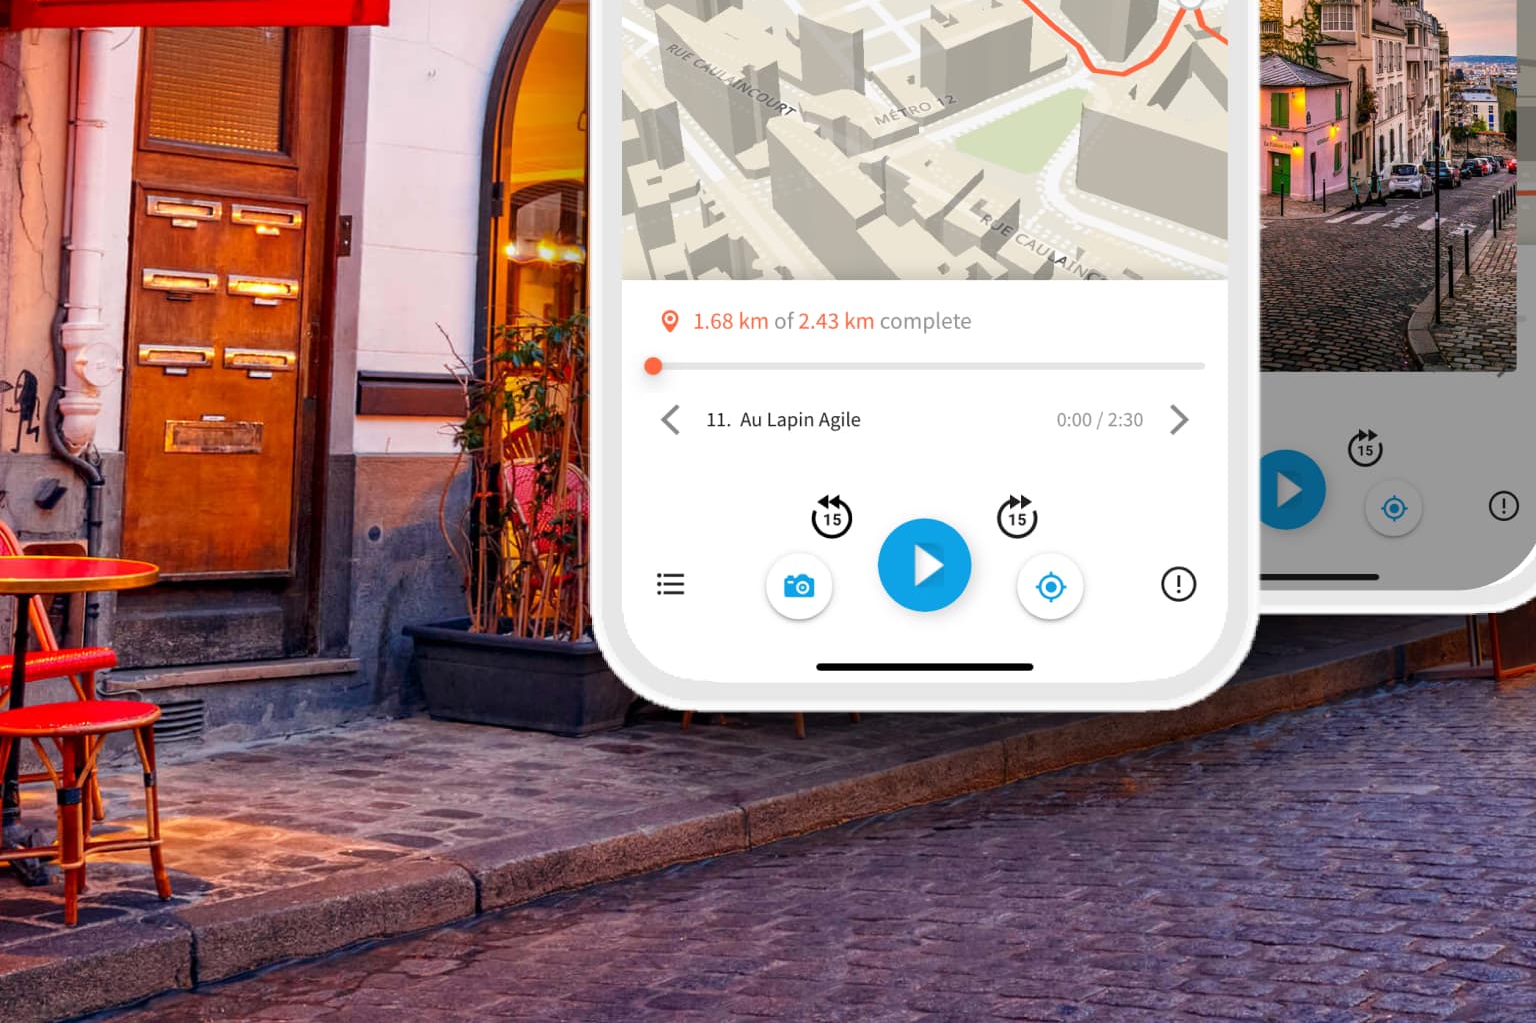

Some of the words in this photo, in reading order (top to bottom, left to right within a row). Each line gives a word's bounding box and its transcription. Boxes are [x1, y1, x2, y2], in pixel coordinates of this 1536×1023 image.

[665, 43, 692, 62] RUE
[692, 56, 798, 117] CAULAINCOURT
[873, 100, 932, 127] MÉTRO
[936, 94, 958, 108] 12
[979, 213, 1015, 237] RUE
[1014, 233, 1109, 280] CAULAINC
[694, 312, 734, 330] 1.68
[739, 311, 769, 330] km
[774, 311, 795, 330] of
[798, 312, 839, 330] 2.43
[845, 311, 875, 330] km
[880, 311, 972, 334] complete
[706, 412, 731, 428] 11.
[739, 411, 762, 428] Au
[767, 411, 814, 432] Lapin
[818, 410, 861, 432] Agile
[1057, 412, 1092, 427] 0:00
[1108, 412, 1143, 427] 2:30
[1357, 444, 1374, 457] 15
[823, 512, 842, 527] 15
[1008, 512, 1027, 527] 15
